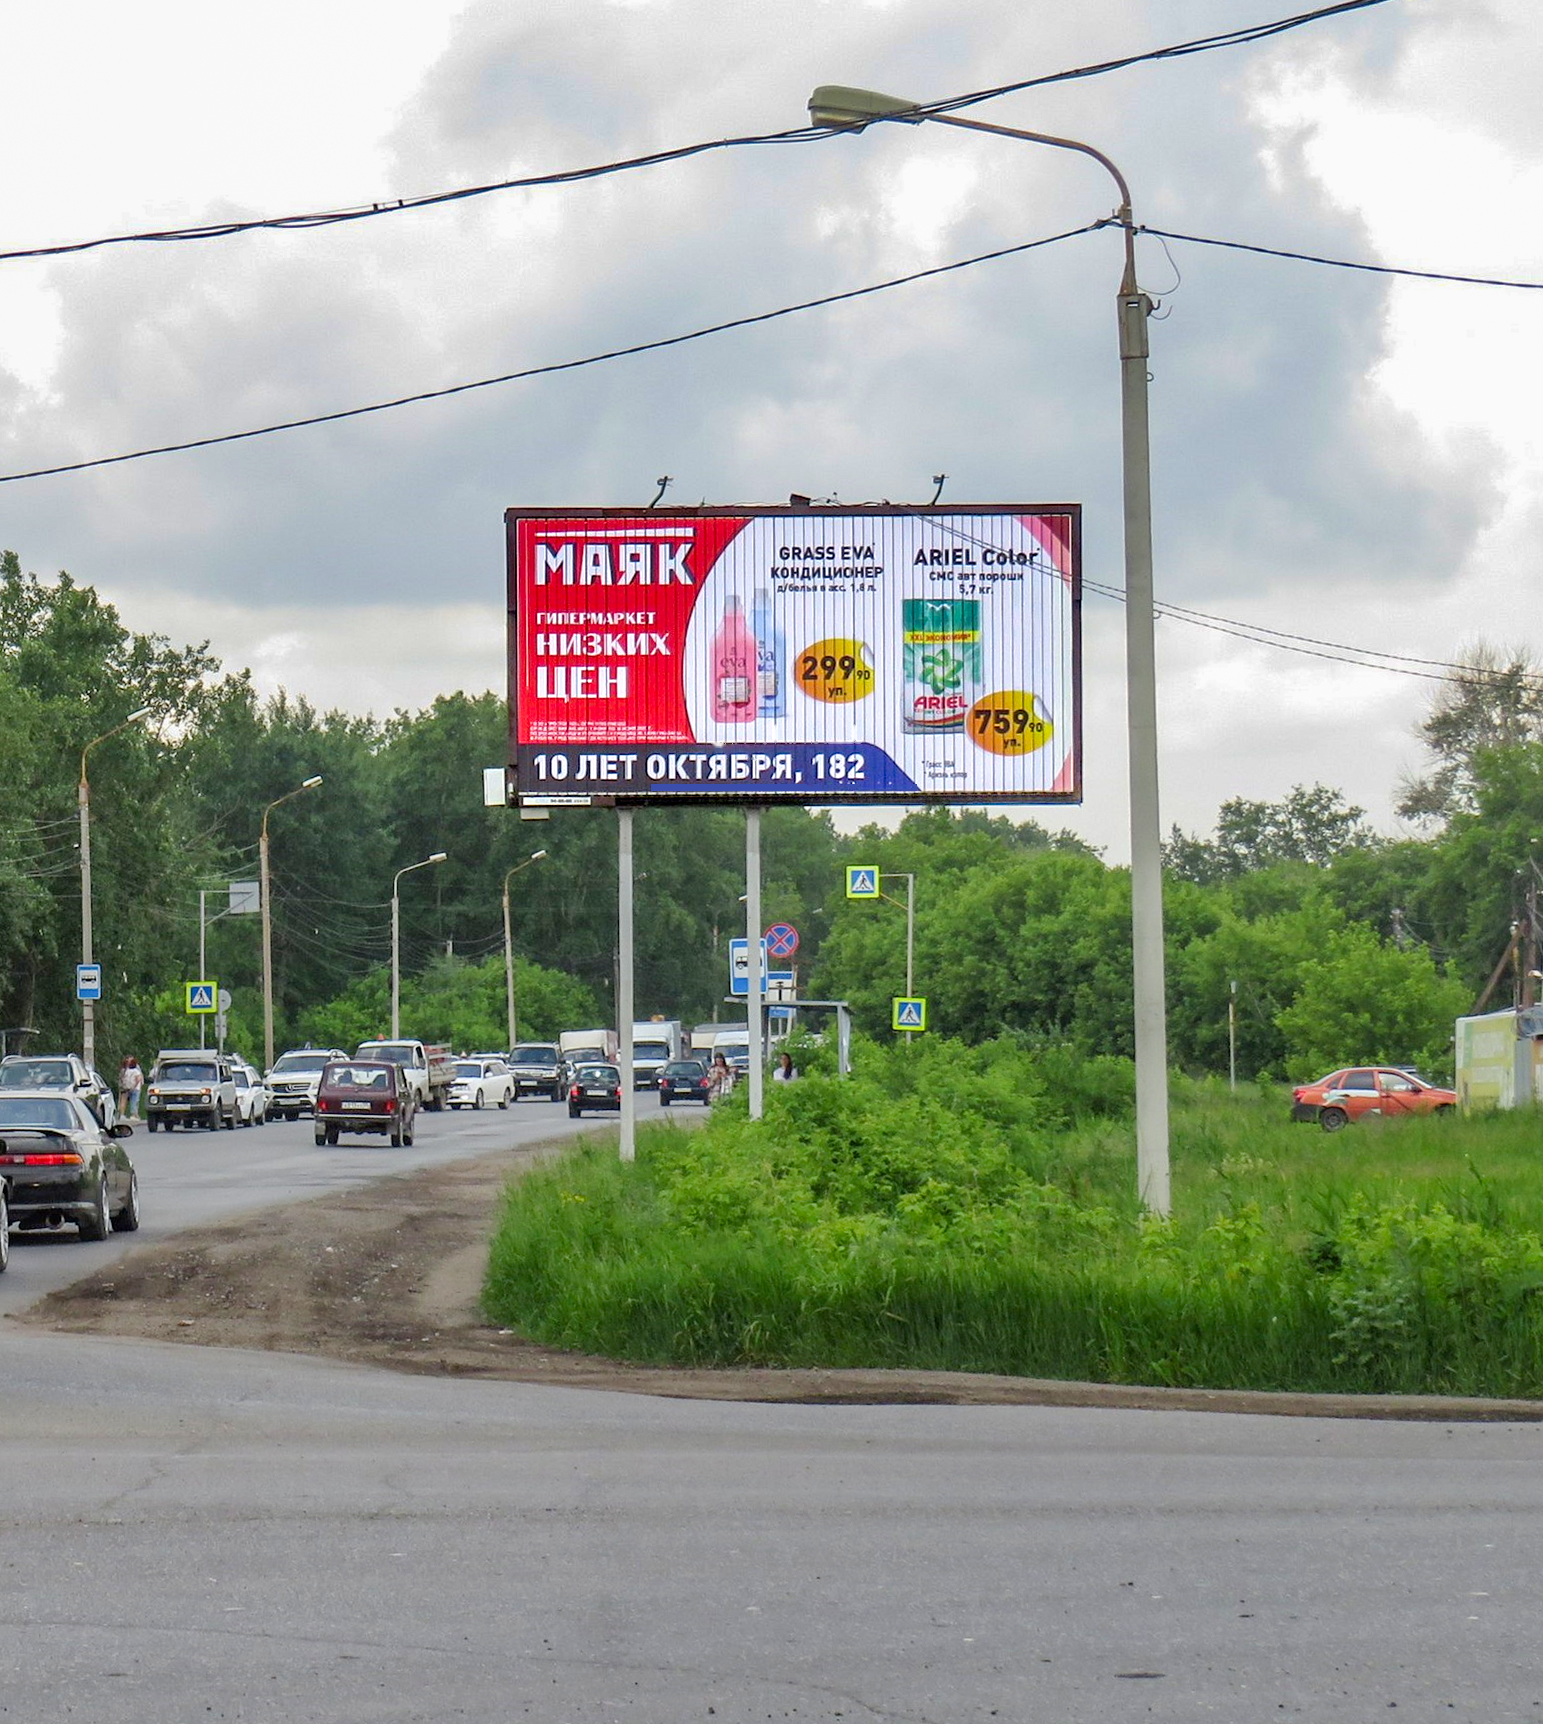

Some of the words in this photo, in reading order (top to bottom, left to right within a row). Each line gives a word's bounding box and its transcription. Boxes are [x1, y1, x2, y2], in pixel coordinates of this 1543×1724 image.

[779, 546, 835, 560] GRASS
[913, 548, 977, 566] ARIEL
[535, 542, 695, 585] МАЯК
[770, 566, 884, 581] КОНДИЦИОНЕР
[536, 612, 656, 625] ГИПЕРМАРКЕТ
[536, 633, 671, 656] НИЗКИХ
[802, 655, 855, 681] 299
[857, 670, 870, 680] 90
[536, 666, 628, 703] ЦЕН
[828, 686, 847, 698] уп.
[914, 695, 968, 710] ARIEL
[975, 709, 1029, 734] 759
[1029, 723, 1043, 732] 90
[534, 754, 569, 780] 10
[575, 754, 638, 780] ЛЕТ
[646, 753, 803, 783] ОКТЯБРЯ,
[812, 753, 865, 779] 182
